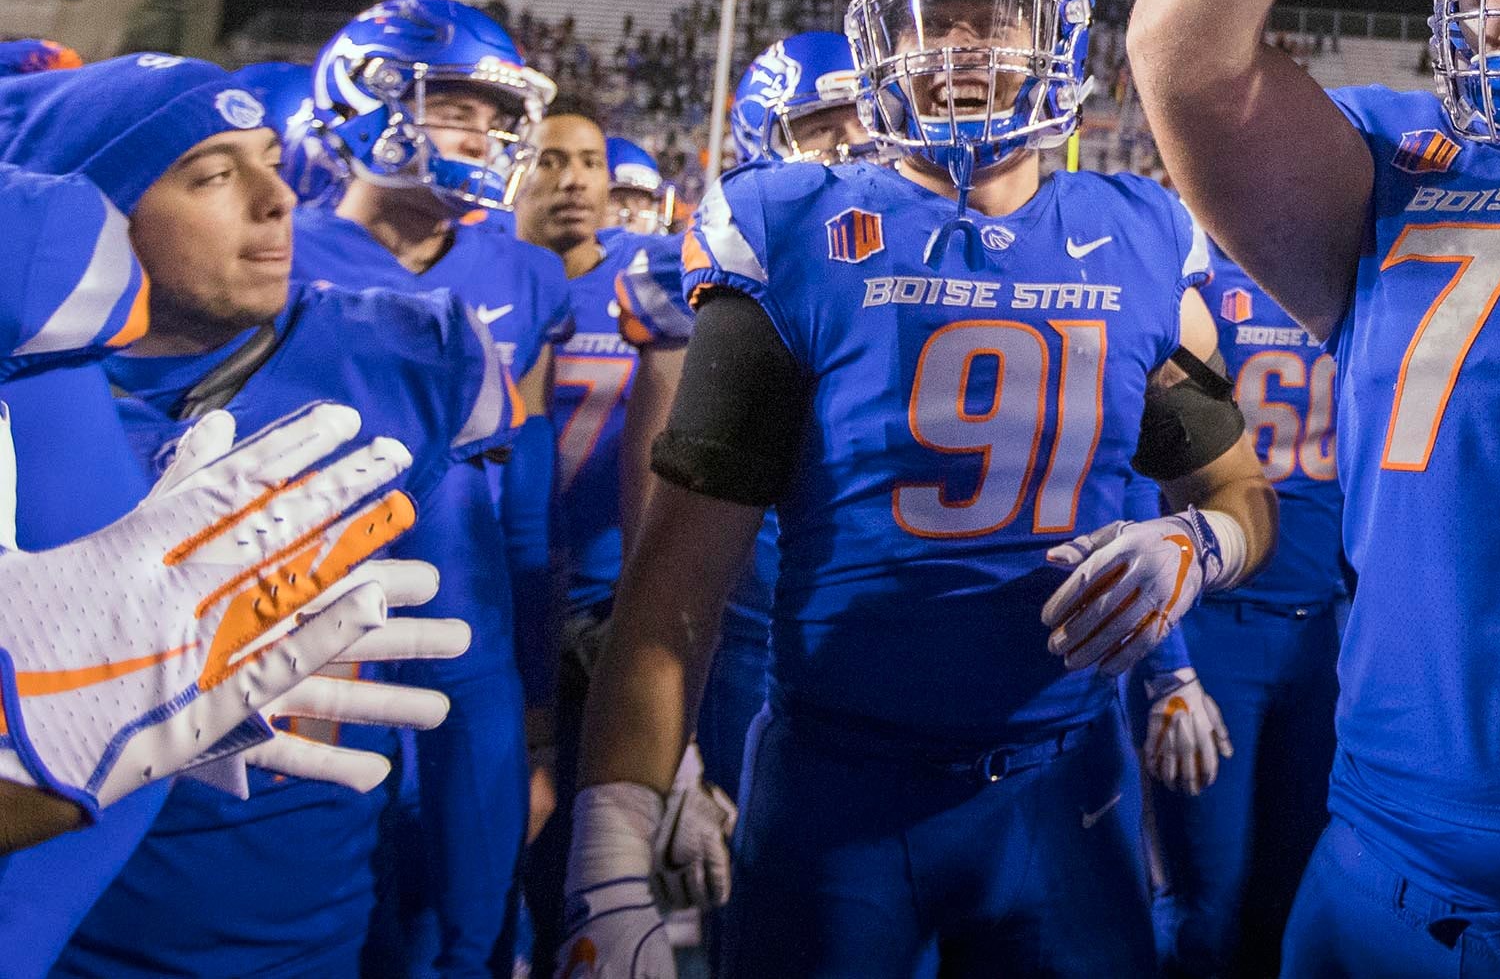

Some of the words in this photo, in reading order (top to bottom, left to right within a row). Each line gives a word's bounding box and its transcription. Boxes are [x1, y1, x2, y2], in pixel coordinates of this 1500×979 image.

[862, 276, 998, 309] BOISE
[1011, 282, 1122, 311] STATE
[892, 320, 1107, 538] 91
